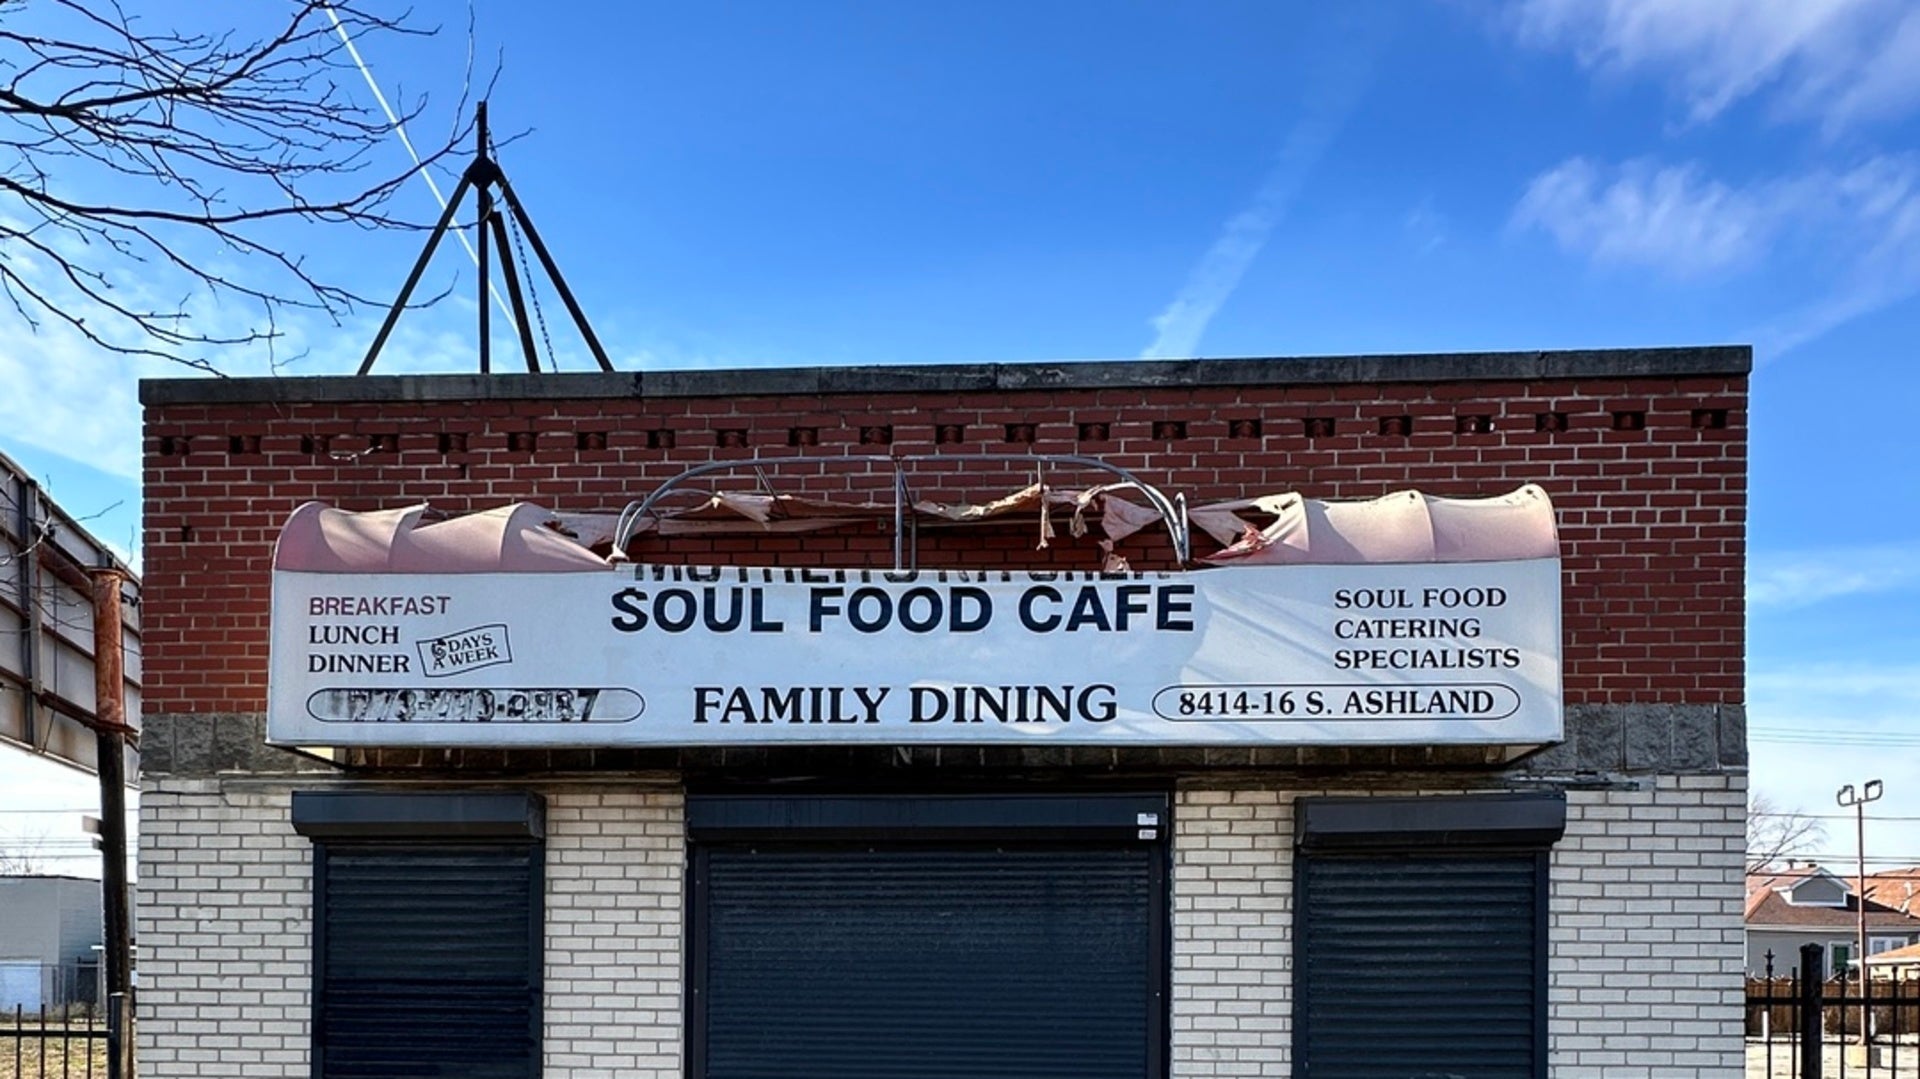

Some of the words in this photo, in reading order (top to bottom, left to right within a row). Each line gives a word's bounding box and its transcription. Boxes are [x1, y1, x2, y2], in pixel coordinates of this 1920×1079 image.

[309, 596, 451, 616] BREAKFAST
[610, 586, 784, 633] SOUL
[809, 586, 993, 633] FOOD
[1018, 584, 1195, 633] CAFE
[1334, 589, 1414, 609] SOUL
[1423, 587, 1507, 608] FOOD
[309, 625, 399, 645] LUNCH
[1334, 618, 1481, 639] CATERING
[448, 633, 493, 652] DAYS
[308, 654, 410, 673] DINNER
[448, 646, 499, 666] WEEK
[1334, 648, 1520, 669] SPECIALISTS
[693, 686, 890, 723] FAMILY
[909, 684, 1117, 723] DINING
[1179, 691, 1295, 715] 8414-16
[1305, 691, 1332, 715] S.
[1343, 690, 1494, 715] ASHLAND
